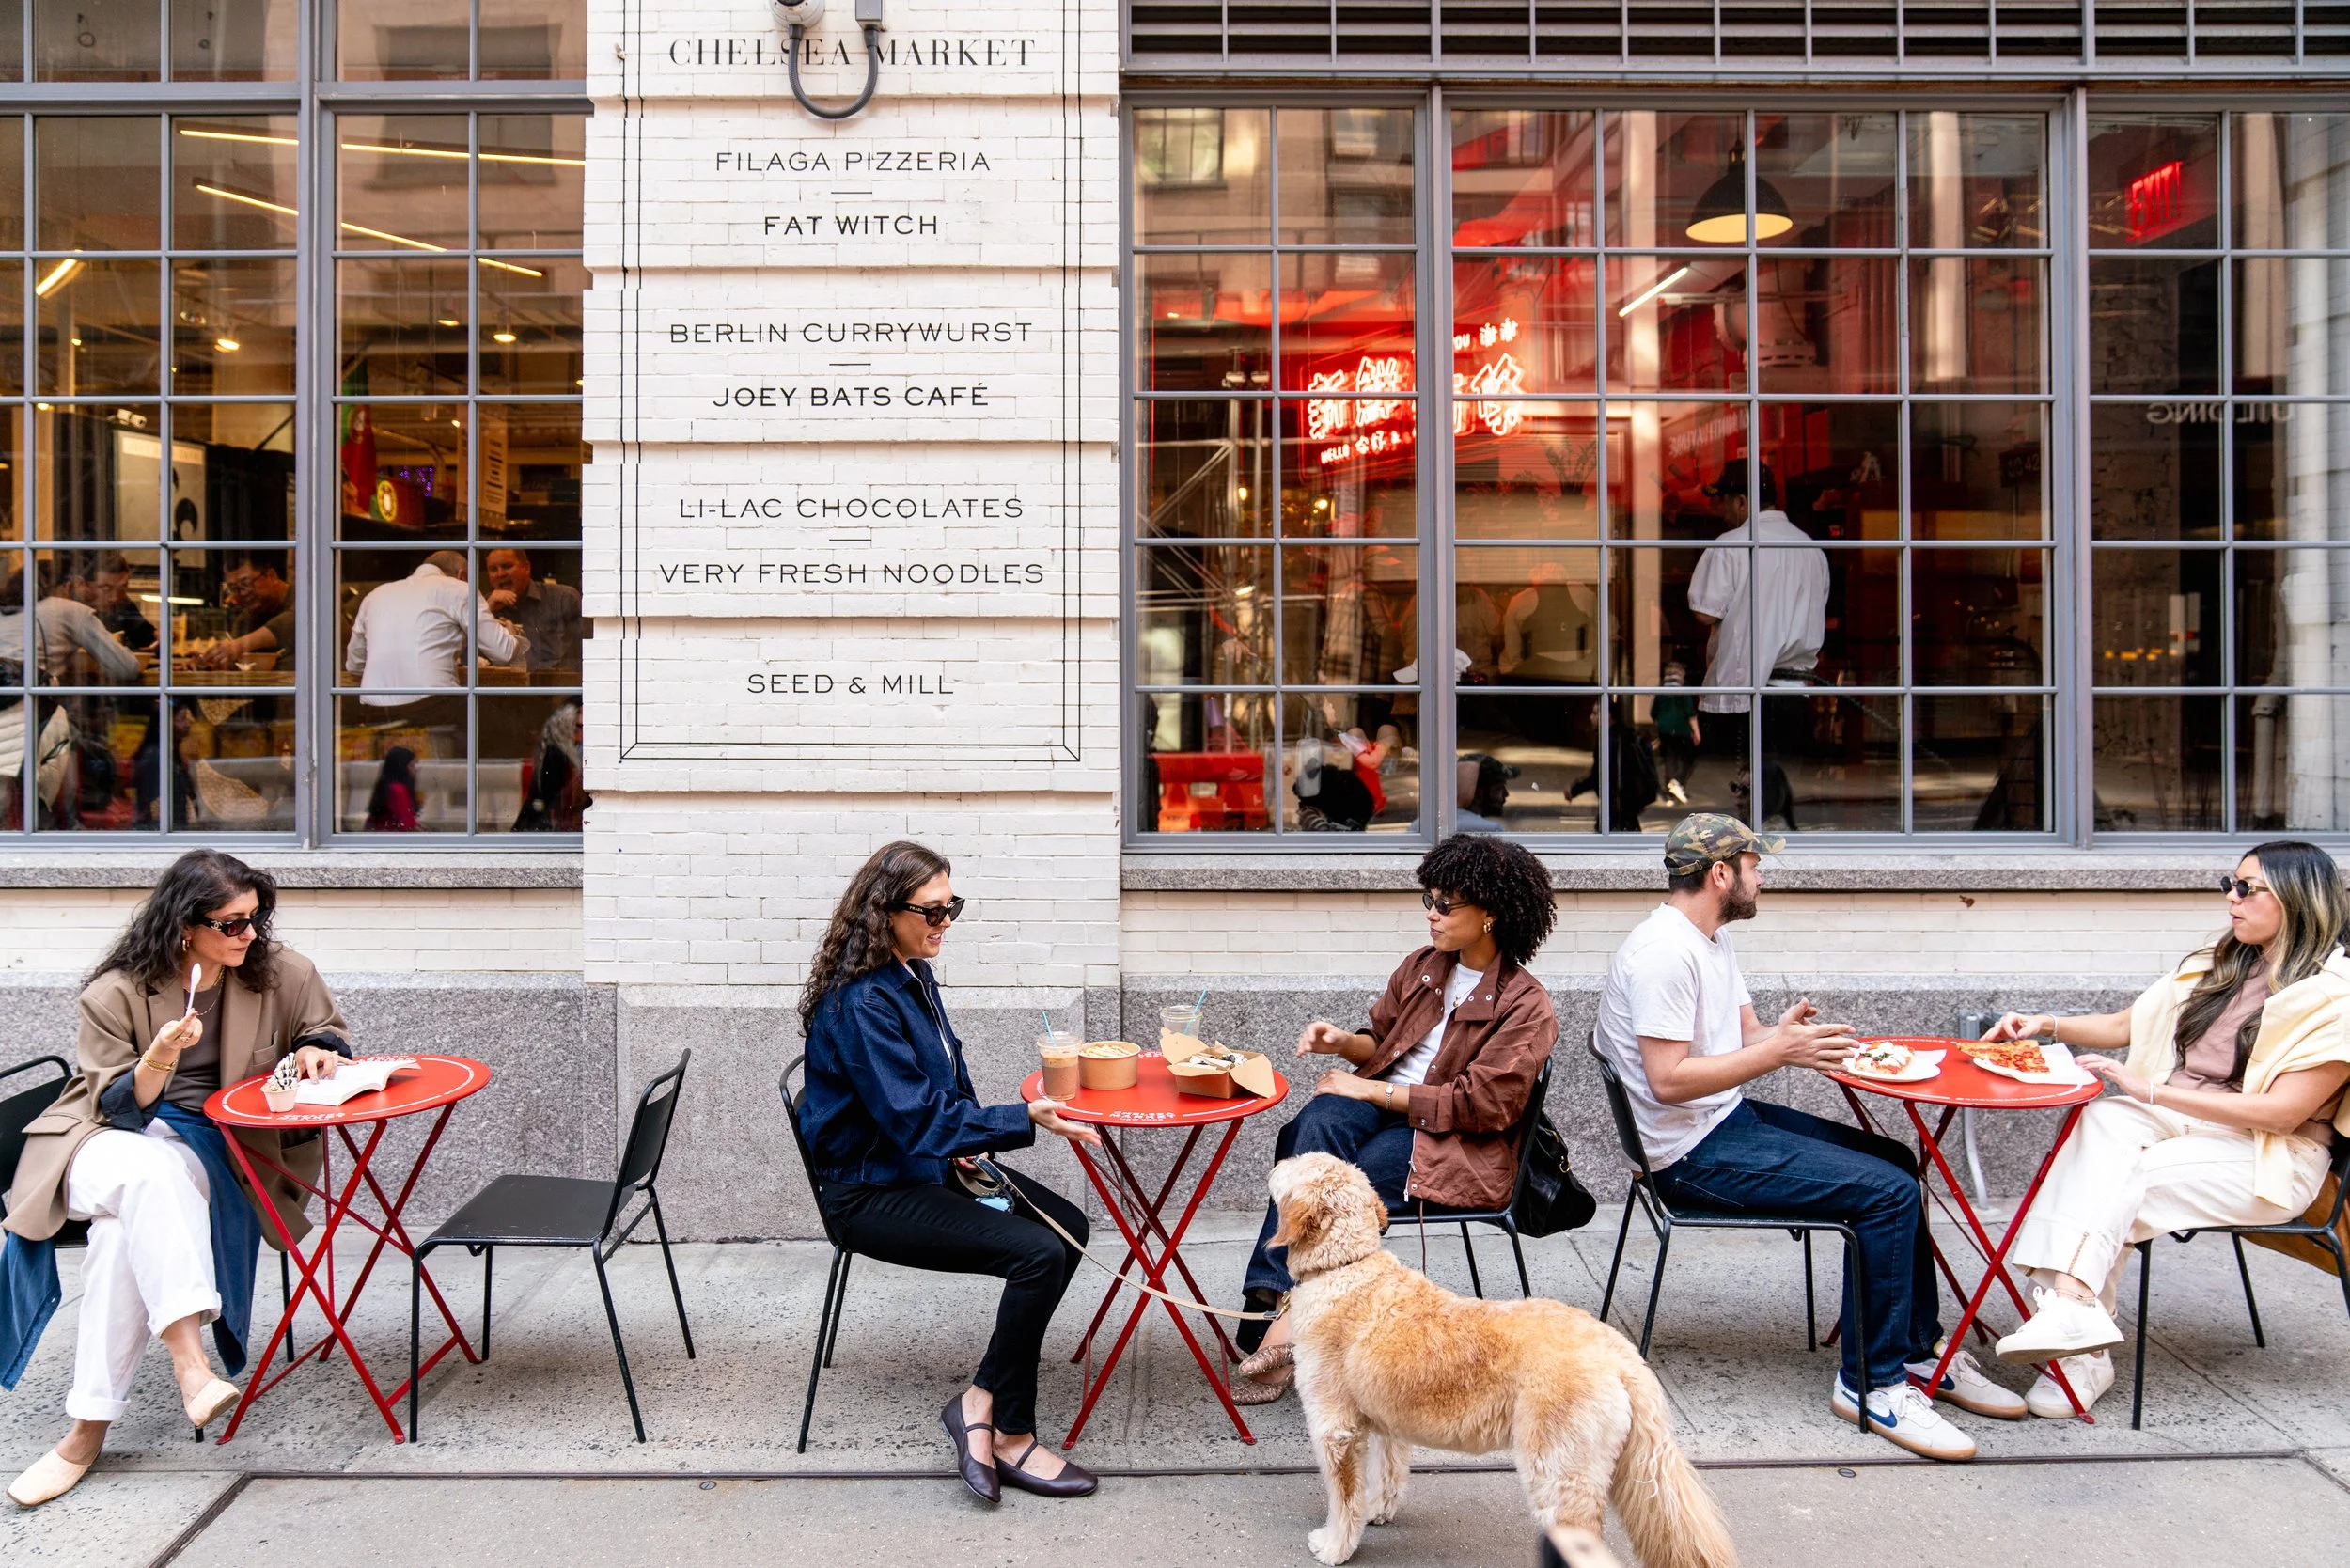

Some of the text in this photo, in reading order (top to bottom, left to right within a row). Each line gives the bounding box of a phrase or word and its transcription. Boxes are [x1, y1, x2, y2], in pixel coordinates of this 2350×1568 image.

[870, 38, 1037, 66] MARKET
[715, 151, 992, 172] FILAGA PIZZERIA
[763, 215, 938, 236] FAT WITCH
[669, 321, 1033, 344] BERLIN CURRYWURST
[712, 382, 990, 408] JOEY BATS CAFÉ
[680, 497, 1025, 519] LI-LAC CHOCOLATES
[659, 563, 1044, 584] VERY FRESH NOODLES
[746, 673, 955, 695] SEED & MILL
